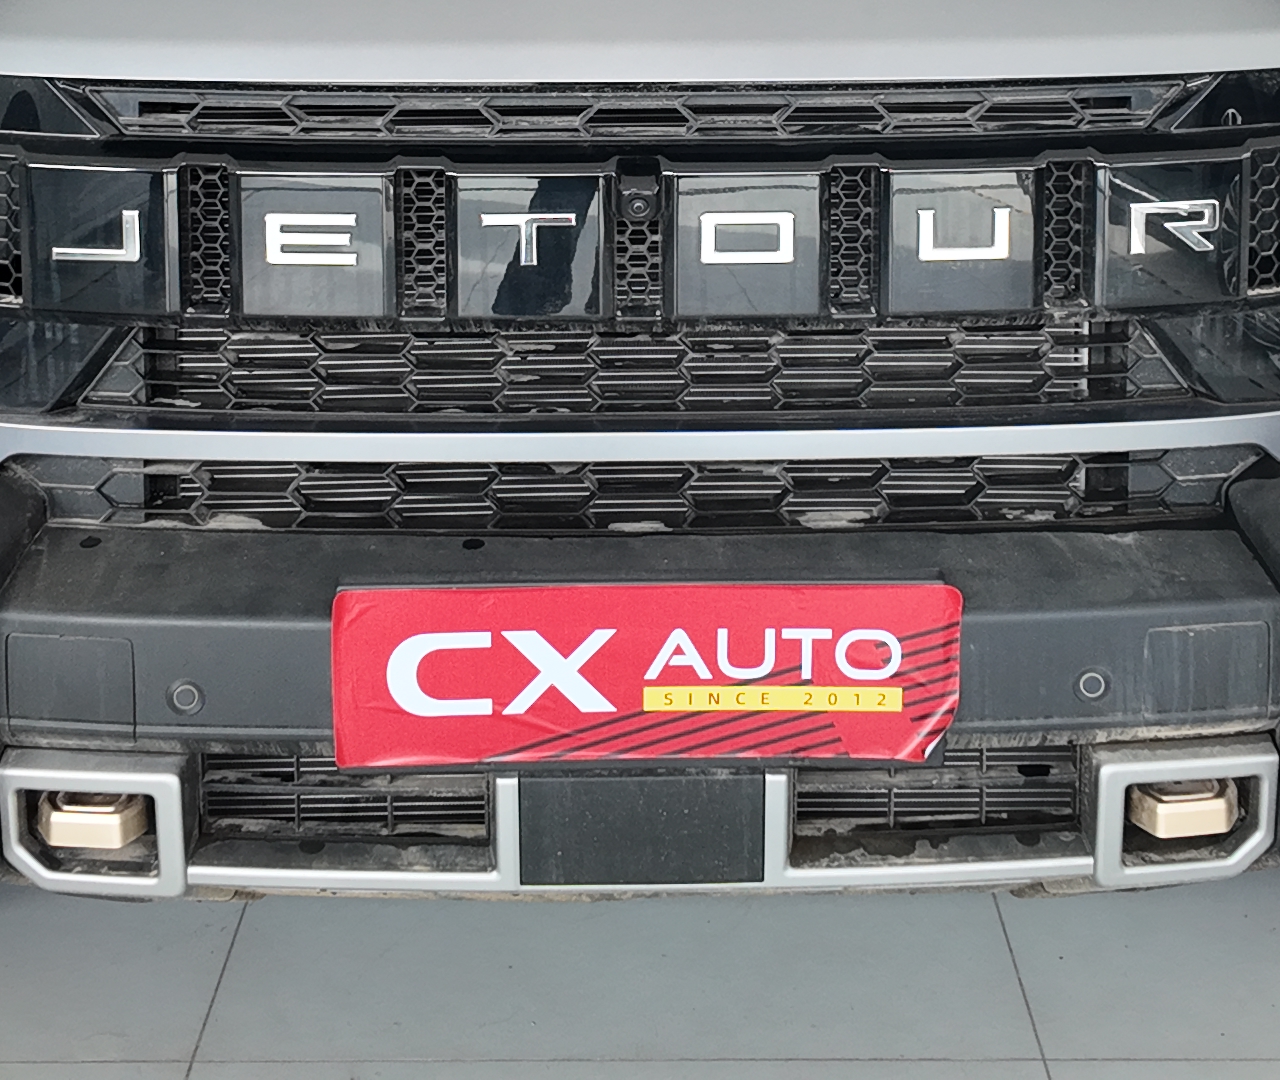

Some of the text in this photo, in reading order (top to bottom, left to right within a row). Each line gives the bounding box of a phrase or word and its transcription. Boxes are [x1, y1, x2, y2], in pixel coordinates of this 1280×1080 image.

[386, 627, 903, 717] CX AUTO
[663, 692, 887, 707] SINCE 2012
